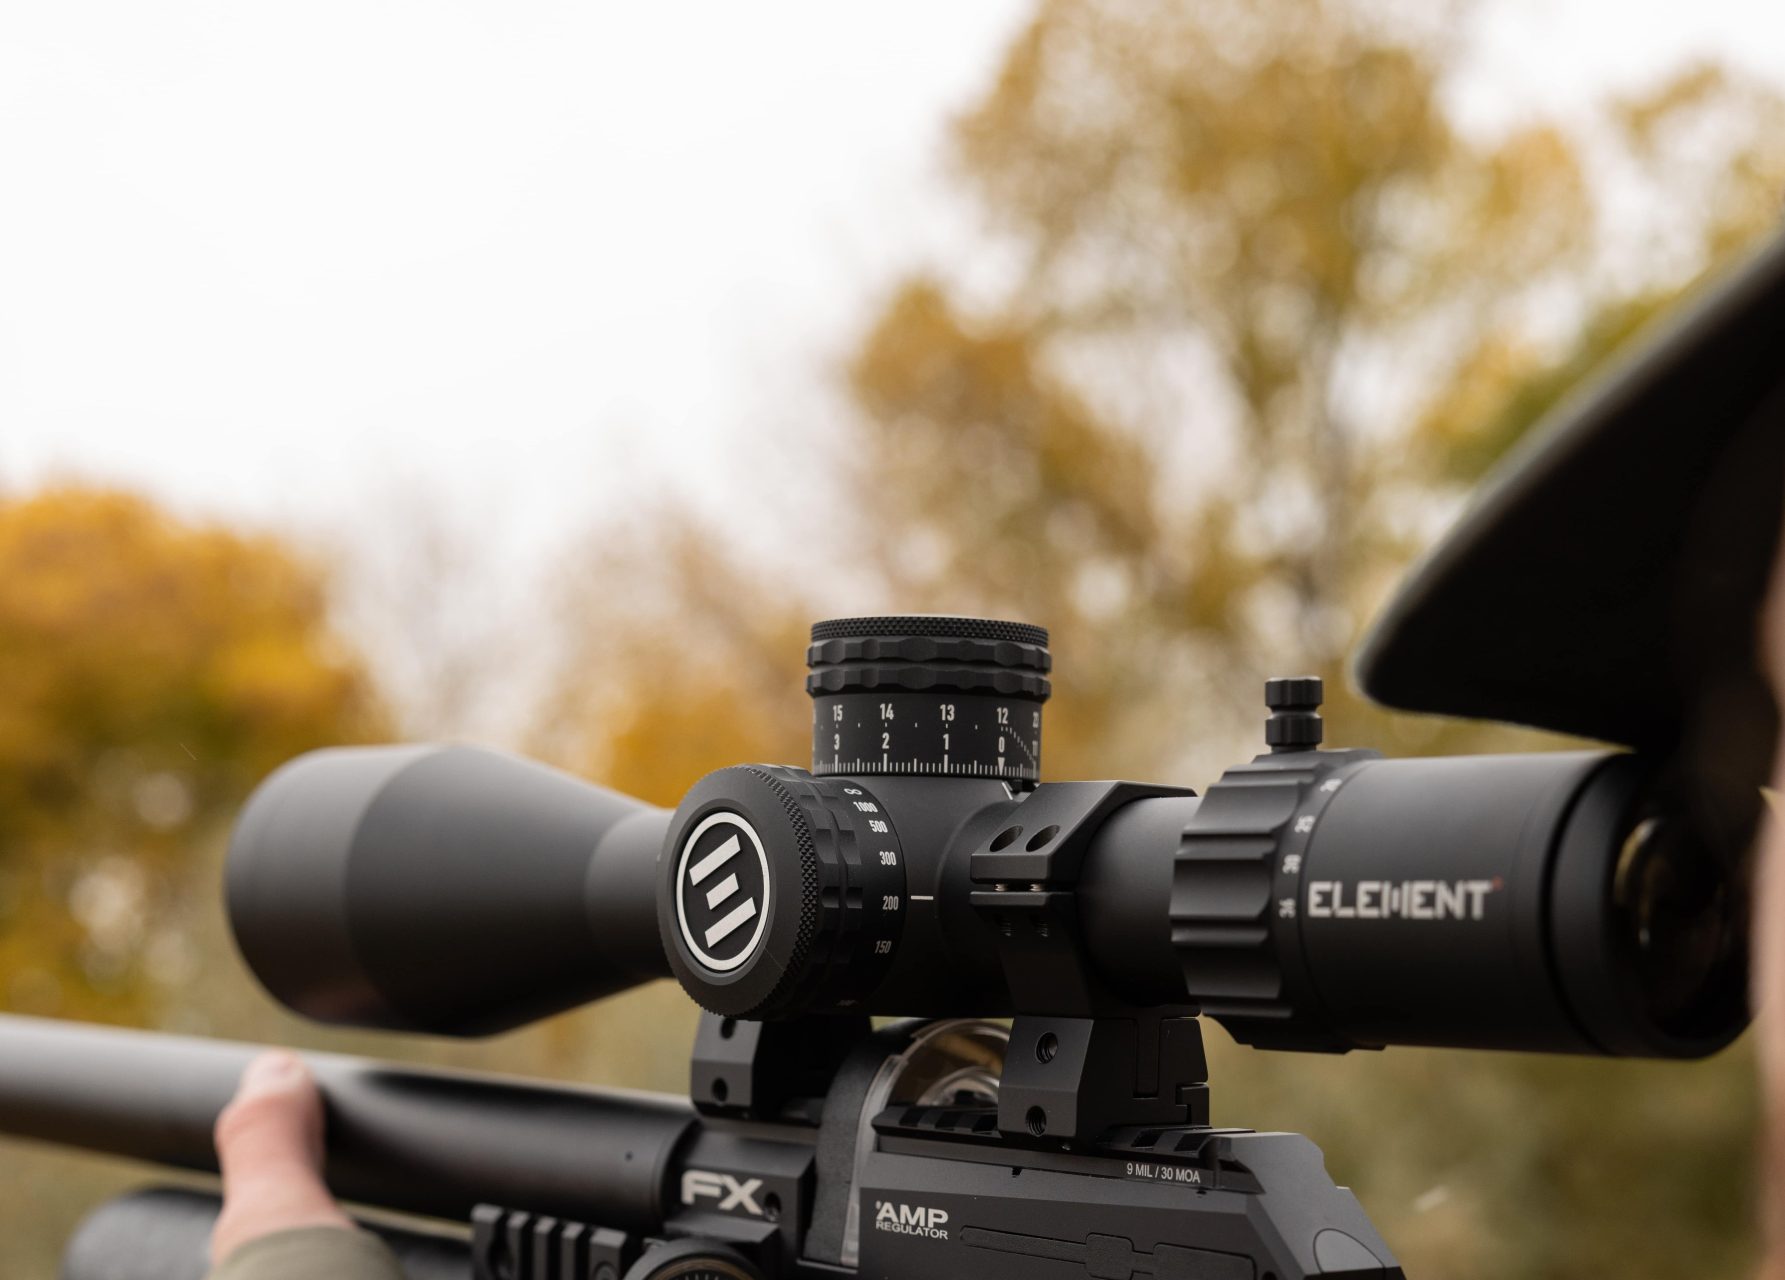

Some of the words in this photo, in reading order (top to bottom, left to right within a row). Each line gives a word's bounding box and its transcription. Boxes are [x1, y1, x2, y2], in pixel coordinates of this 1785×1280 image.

[833, 704, 843, 722] 15
[880, 703, 894, 720] 14
[940, 704, 955, 721] 13
[997, 707, 1008, 724] 12
[834, 734, 840, 750] 3
[882, 733, 889, 749] 2
[943, 734, 950, 750] 1
[998, 736, 1005, 753] 0
[853, 801, 878, 813] 1000
[869, 820, 888, 833] 500
[1294, 815, 1315, 833] 25
[880, 852, 897, 866] 300
[1282, 854, 1301, 874] 30
[882, 895, 899, 911] 200
[1308, 880, 1492, 920] ELEMENT
[874, 940, 891, 954] 150
[1127, 1163, 1133, 1175] 9
[1135, 1167, 1153, 1177] MIL
[1161, 1169, 1173, 1180] 30
[1175, 1170, 1200, 1184] MOA
[681, 1170, 764, 1216] FX
[876, 1220, 948, 1240] REGULATOR
